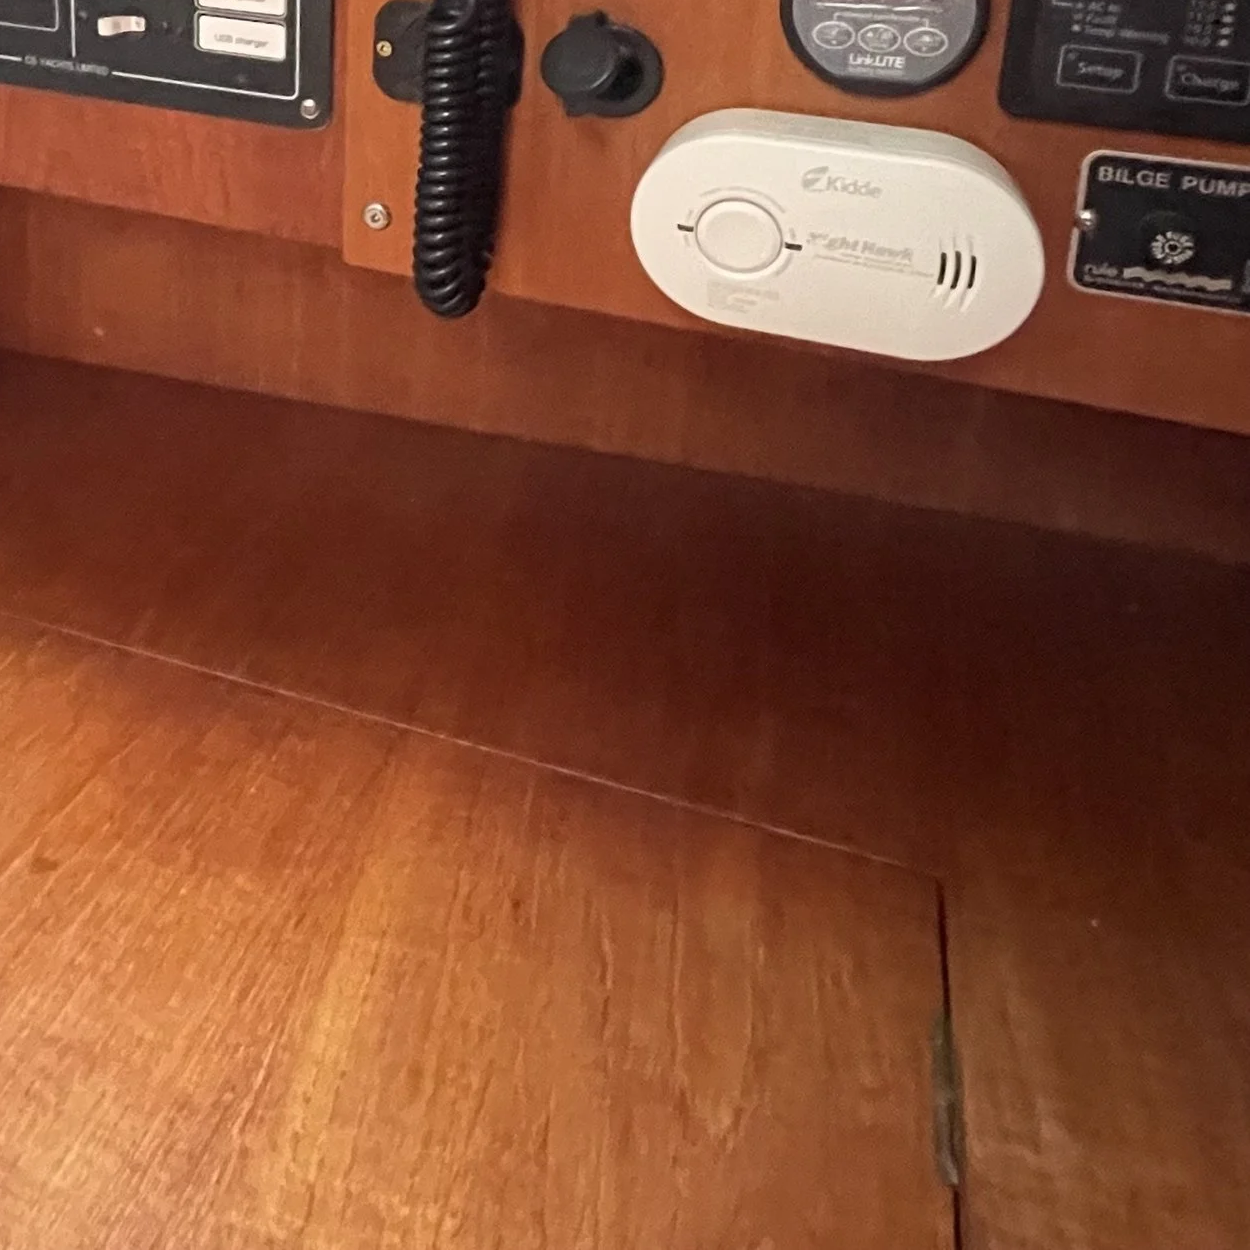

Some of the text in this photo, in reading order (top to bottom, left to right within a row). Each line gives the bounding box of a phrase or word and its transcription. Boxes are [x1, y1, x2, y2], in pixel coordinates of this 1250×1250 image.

[825, 175, 884, 199] Kidde
[1097, 164, 1250, 198] BILGE PUMP
